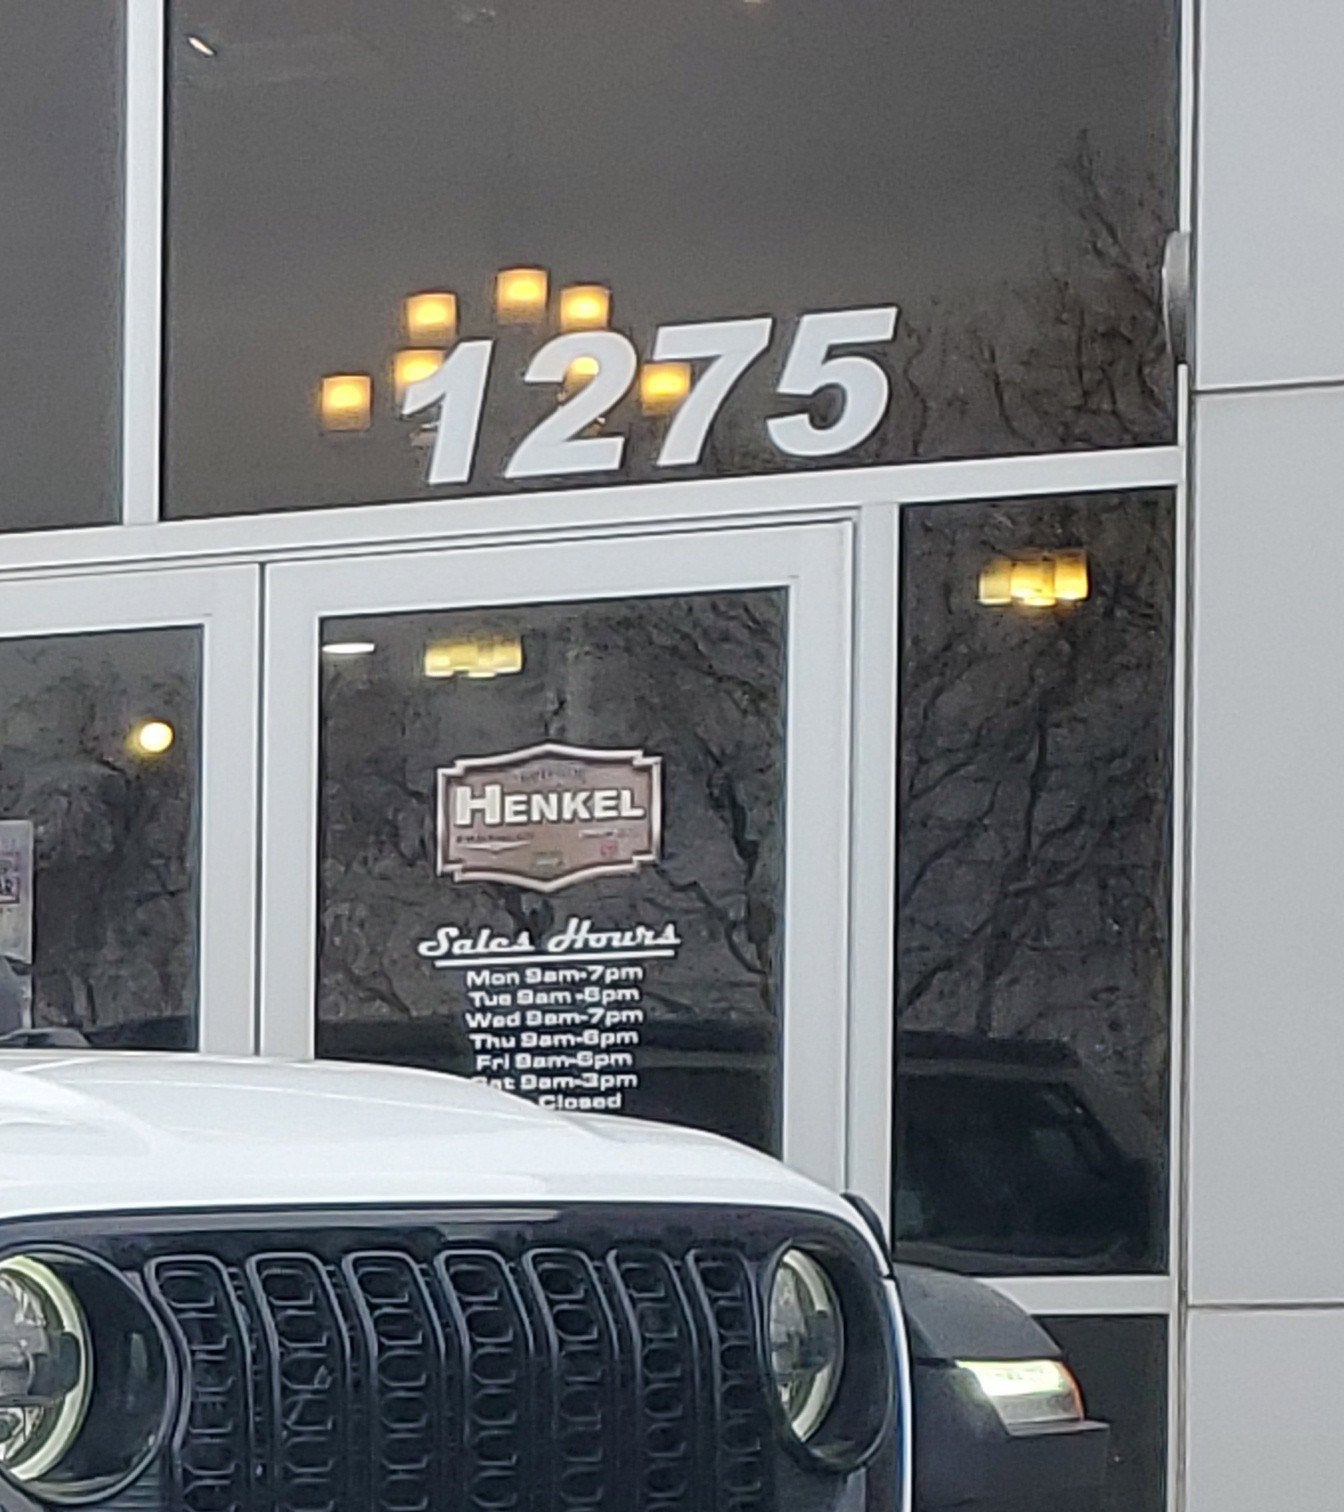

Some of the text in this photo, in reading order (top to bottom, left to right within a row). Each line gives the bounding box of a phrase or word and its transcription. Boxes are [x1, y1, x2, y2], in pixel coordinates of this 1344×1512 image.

[400, 305, 900, 485] 1275
[453, 783, 646, 828] HENKEL
[417, 917, 682, 957] Sales Hours
[465, 970, 520, 987] Mon
[469, 991, 512, 1007] Tue
[465, 1010, 521, 1028] Wed
[469, 1032, 516, 1049] Thu
[476, 1054, 510, 1071] Fri
[538, 1092, 622, 1110] Closed
